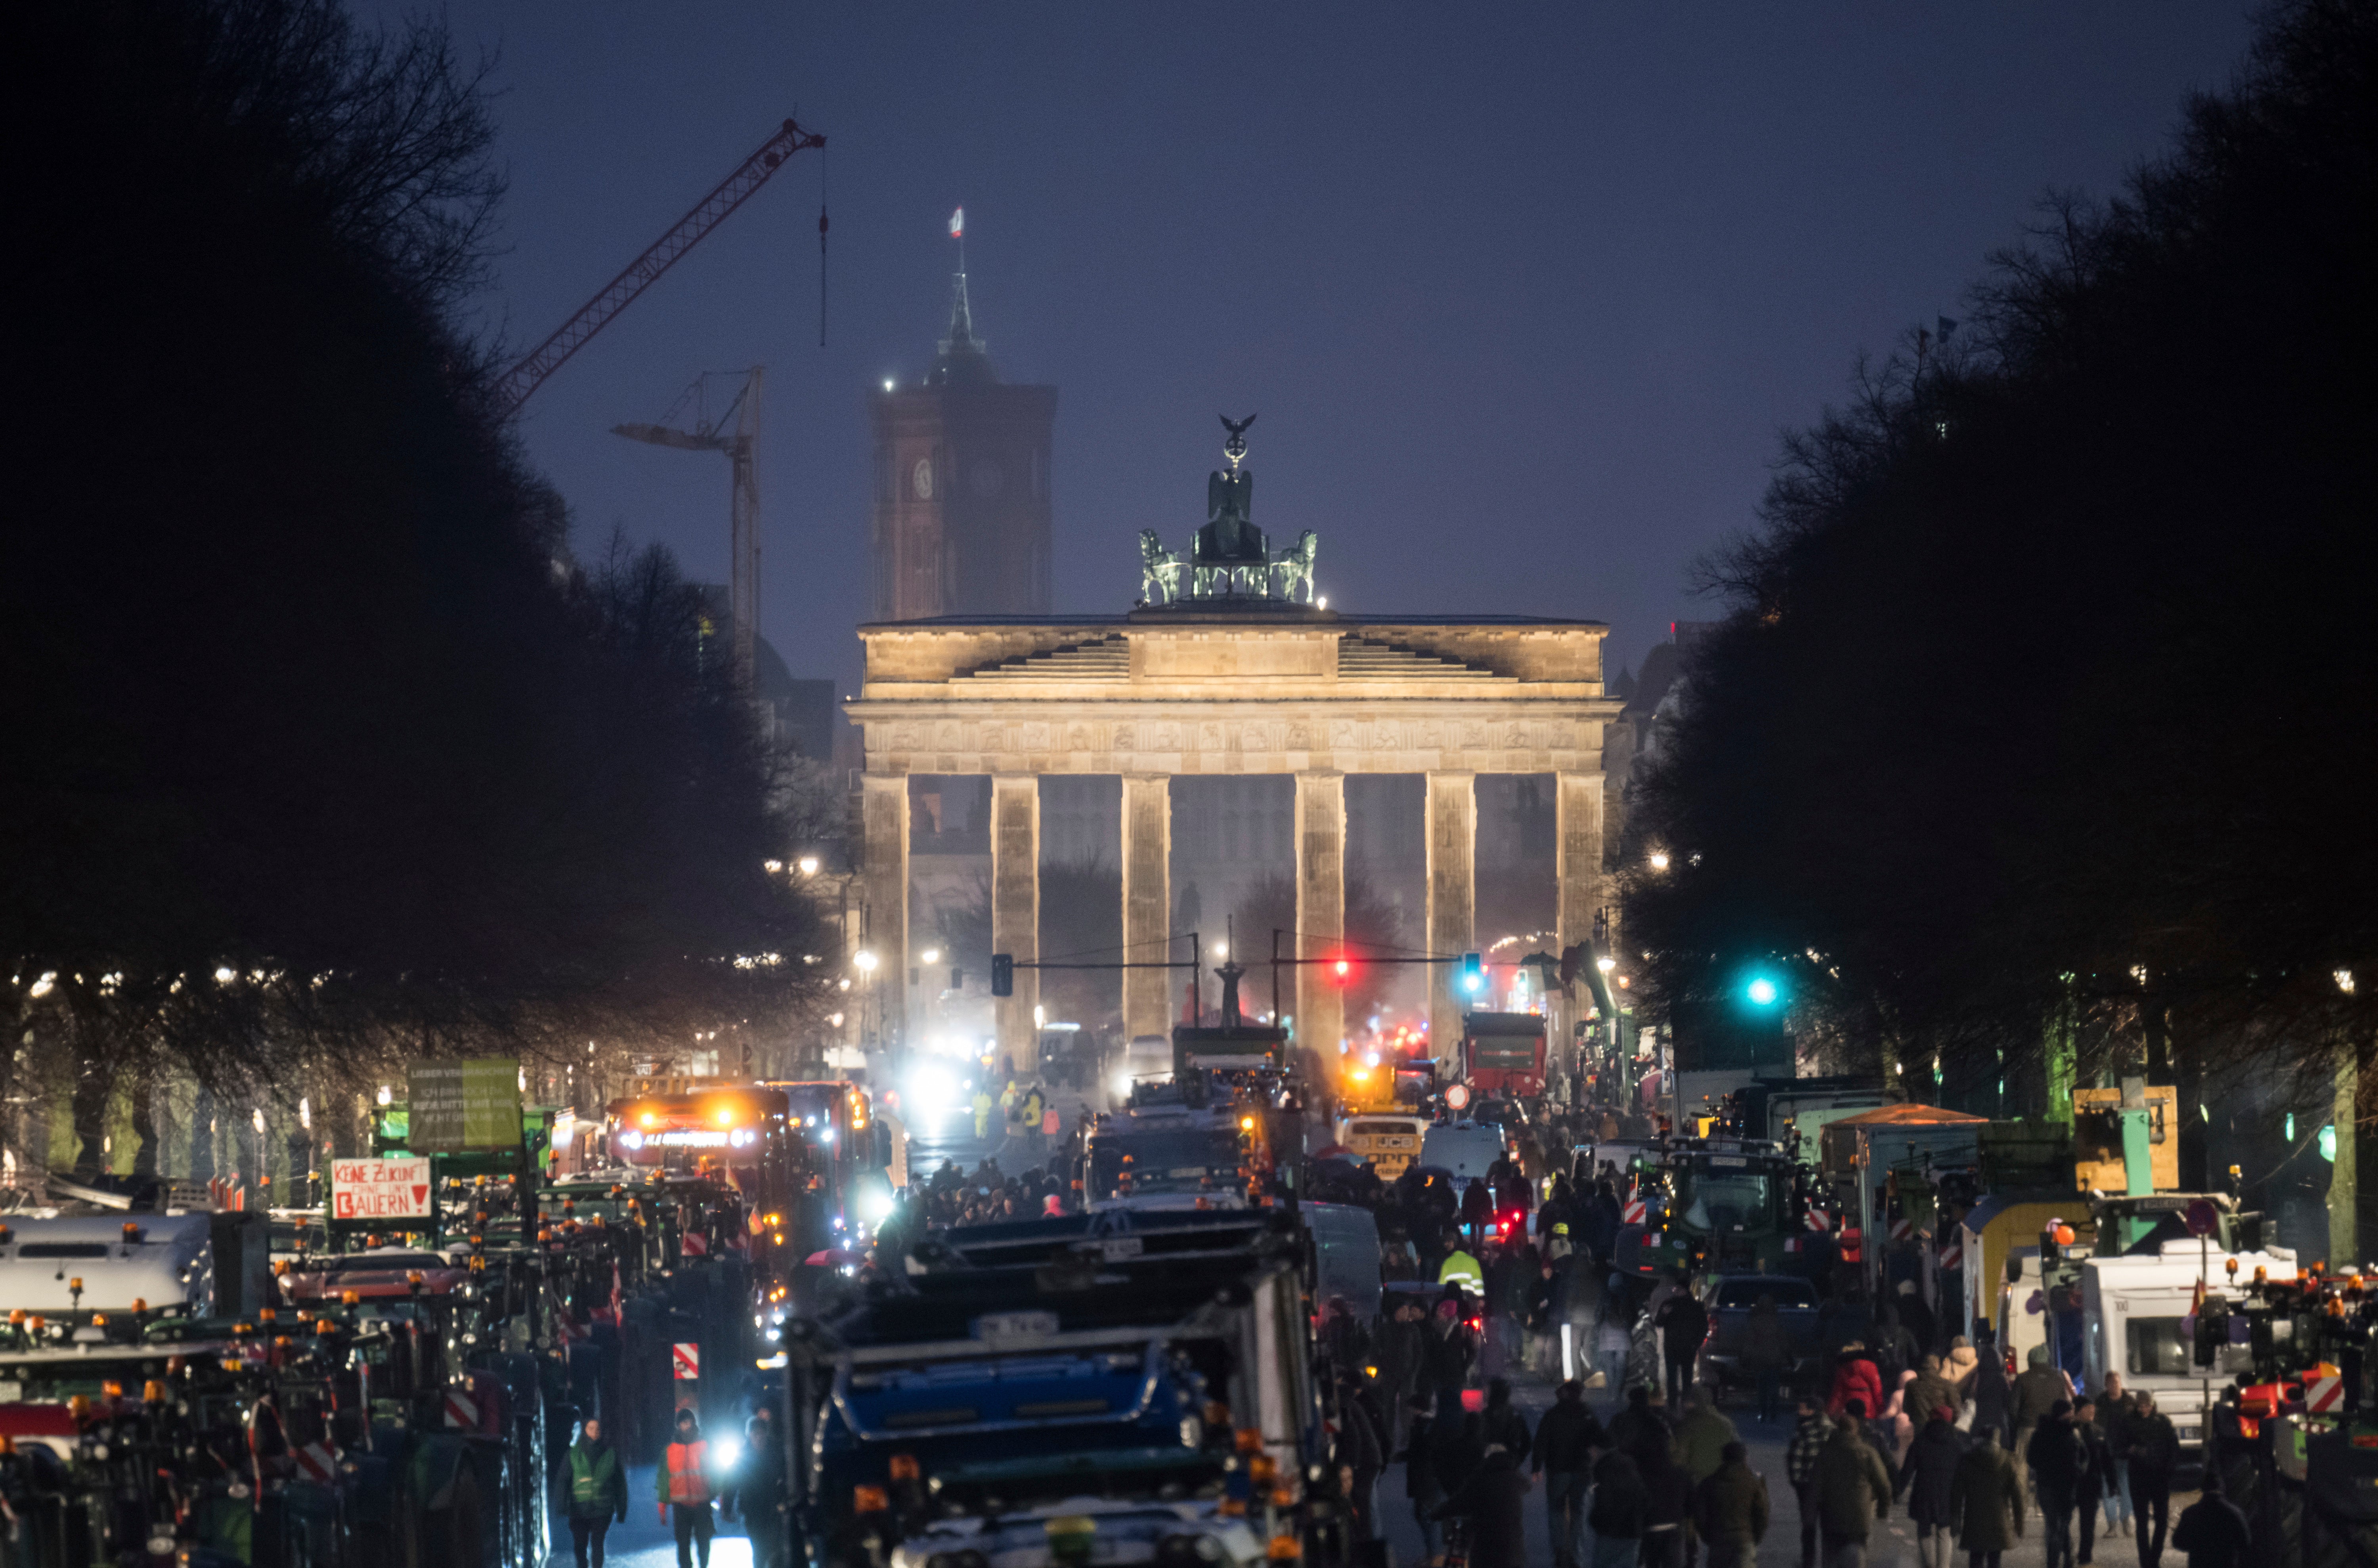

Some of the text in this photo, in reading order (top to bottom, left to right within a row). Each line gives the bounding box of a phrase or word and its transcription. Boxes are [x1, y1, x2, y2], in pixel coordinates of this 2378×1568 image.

[1378, 1137, 1414, 1148] JCB
[334, 1162, 428, 1183] KEINE ZUKUNFT
[352, 1184, 408, 1195] OHNE UNS
